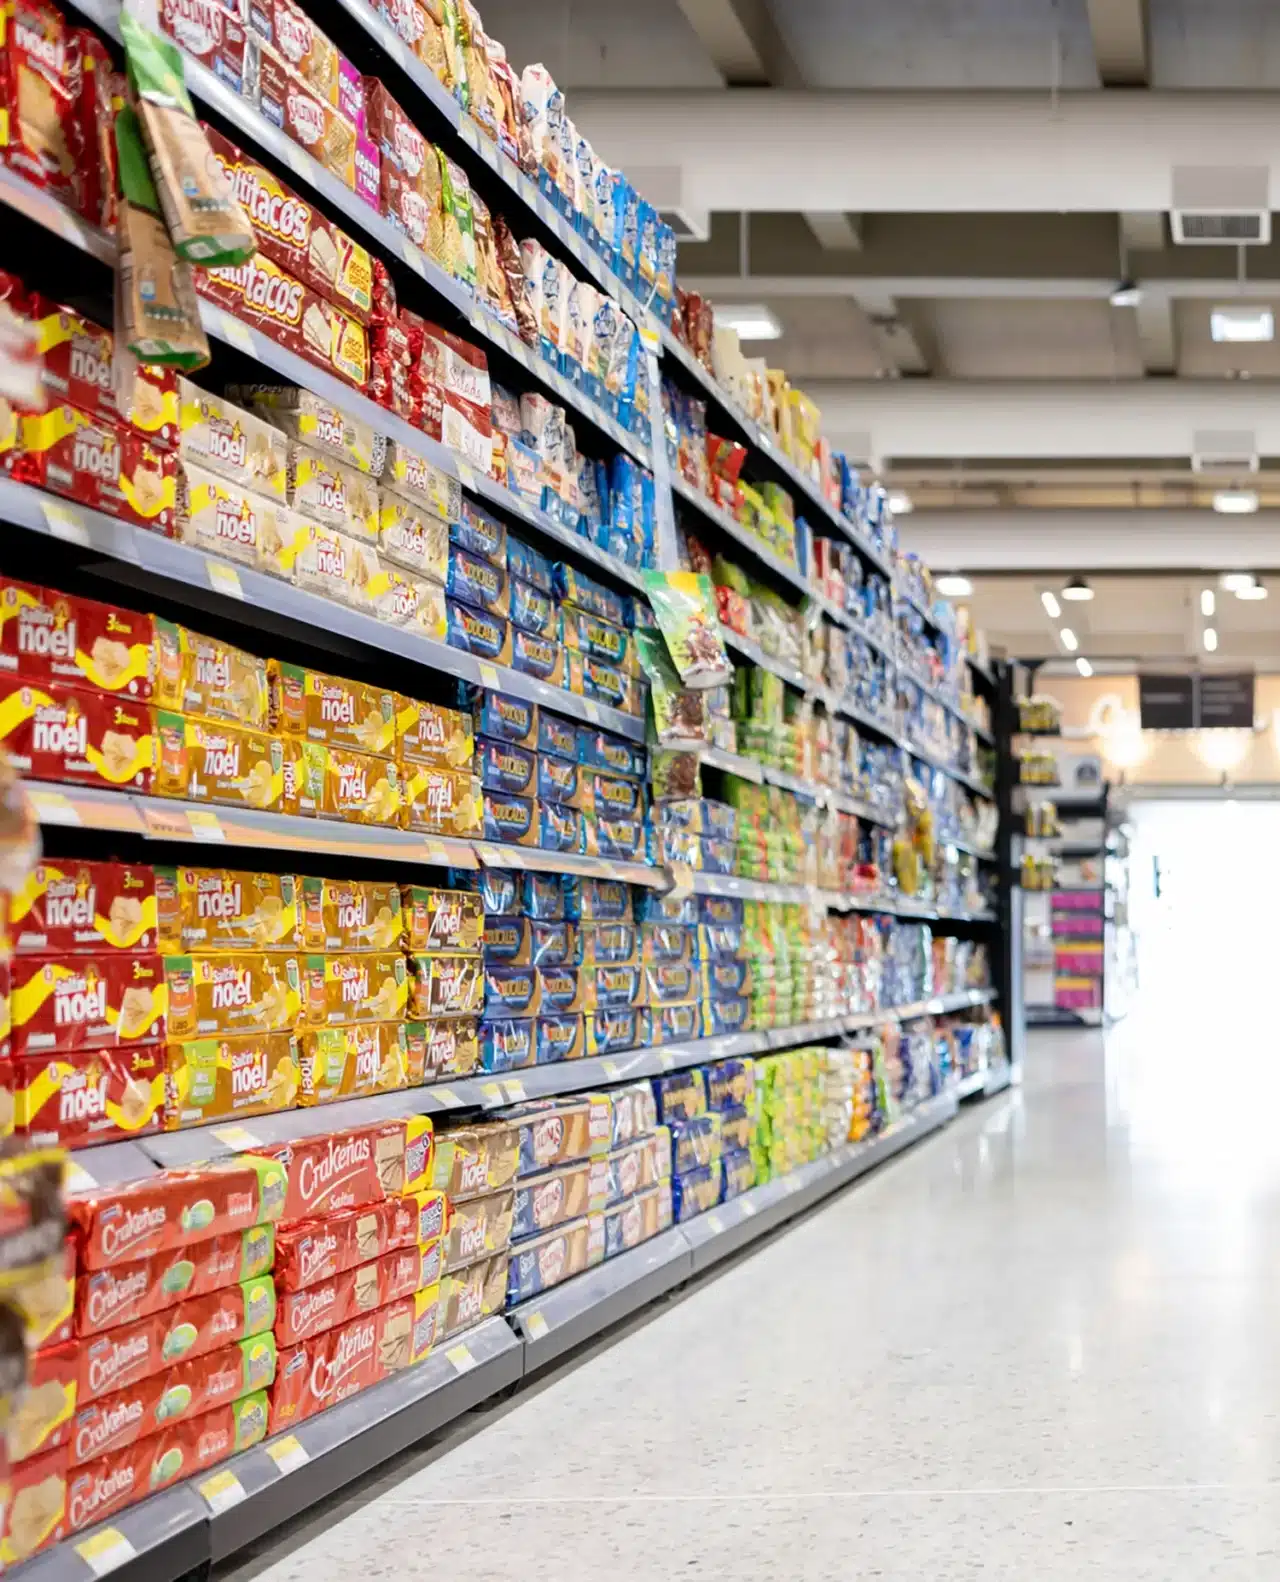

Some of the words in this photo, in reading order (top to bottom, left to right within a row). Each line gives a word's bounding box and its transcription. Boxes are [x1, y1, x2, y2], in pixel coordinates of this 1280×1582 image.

[208, 430, 247, 468] noel
[316, 420, 345, 446] noel
[216, 511, 257, 546] noel
[317, 551, 345, 577] noel
[18, 620, 76, 658] noel
[321, 695, 354, 724] noel
[33, 715, 87, 755] noel
[204, 744, 239, 777] noel
[47, 884, 96, 926] noel
[197, 883, 241, 918] noel
[338, 896, 367, 929] noel
[55, 979, 106, 1024] noel
[212, 970, 252, 1009] noel
[231, 1054, 268, 1095] noel
[60, 1075, 108, 1122] noel
[300, 1135, 370, 1200] Crakeñas
